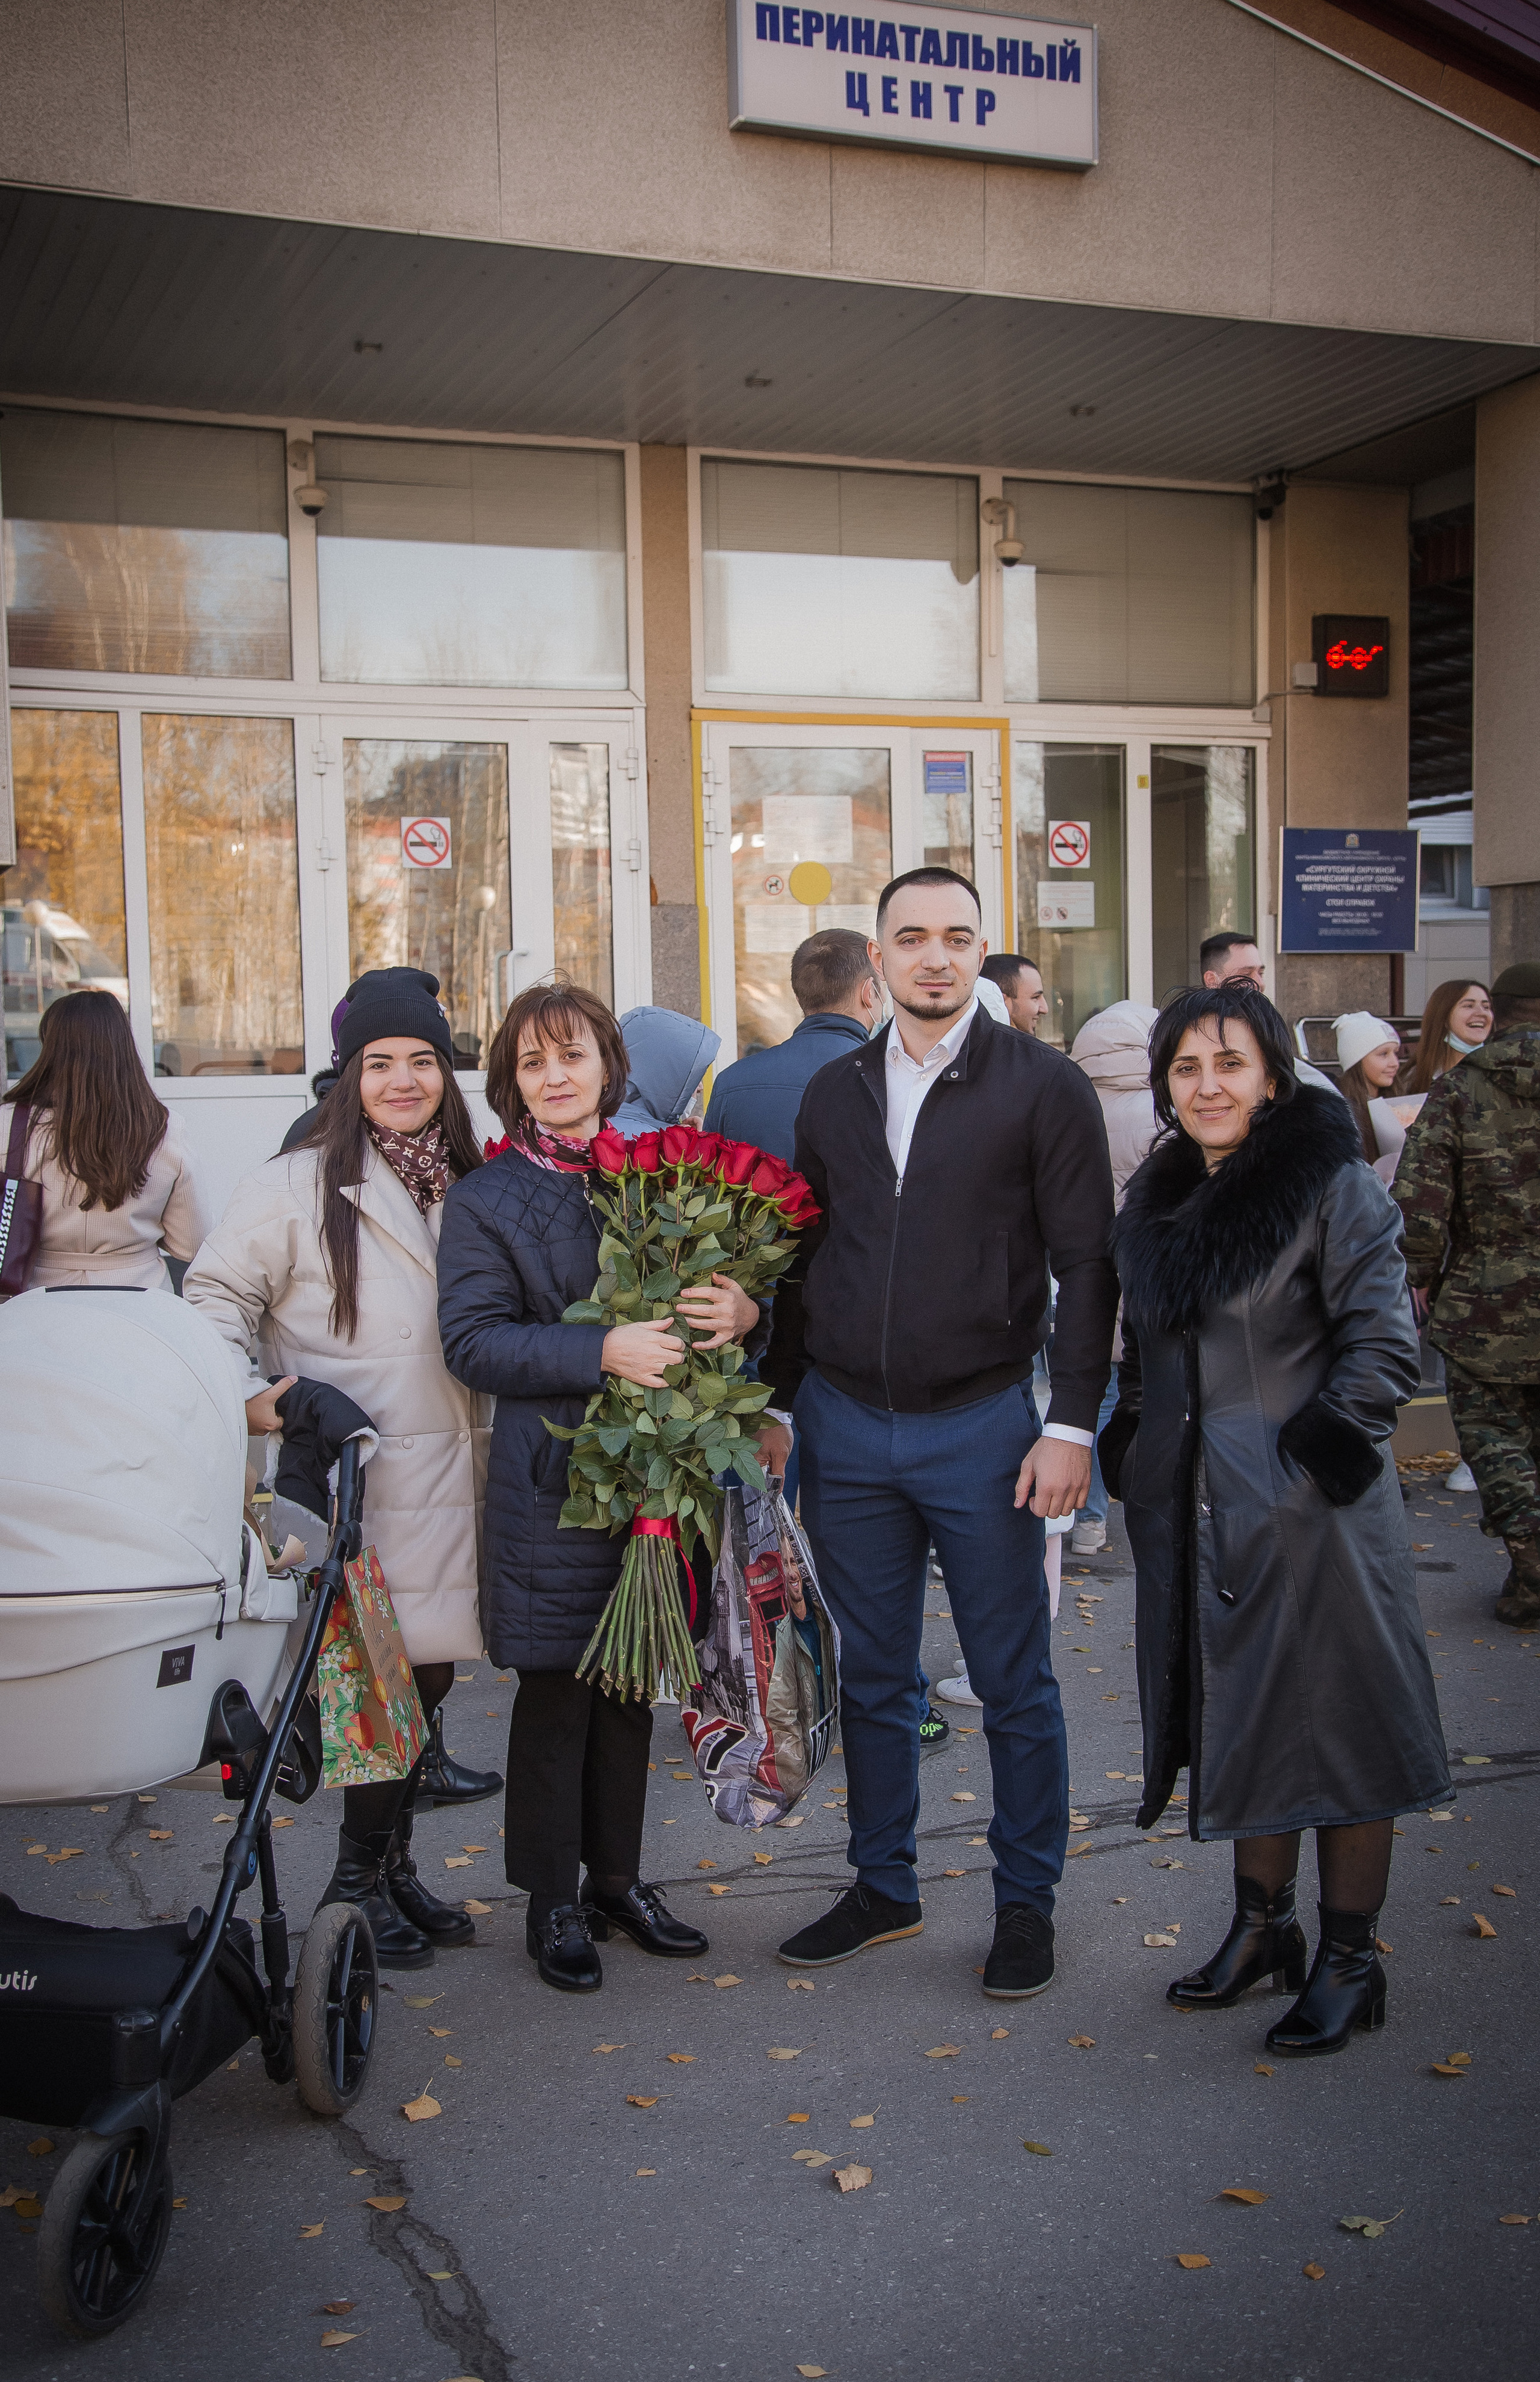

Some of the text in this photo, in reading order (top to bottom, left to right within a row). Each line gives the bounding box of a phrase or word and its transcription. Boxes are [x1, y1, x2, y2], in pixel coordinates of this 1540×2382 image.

[756, 1, 1081, 84] ПЕРИНАТАЛЬНЫЙ
[845, 70, 996, 126] ЦЕНТР
[1295, 874, 1405, 884] КЛИНИЧЕСКИЙ ЦЕНТР ОХРАНЫ
[1301, 883, 1355, 892] МАТЕРИНСТВА
